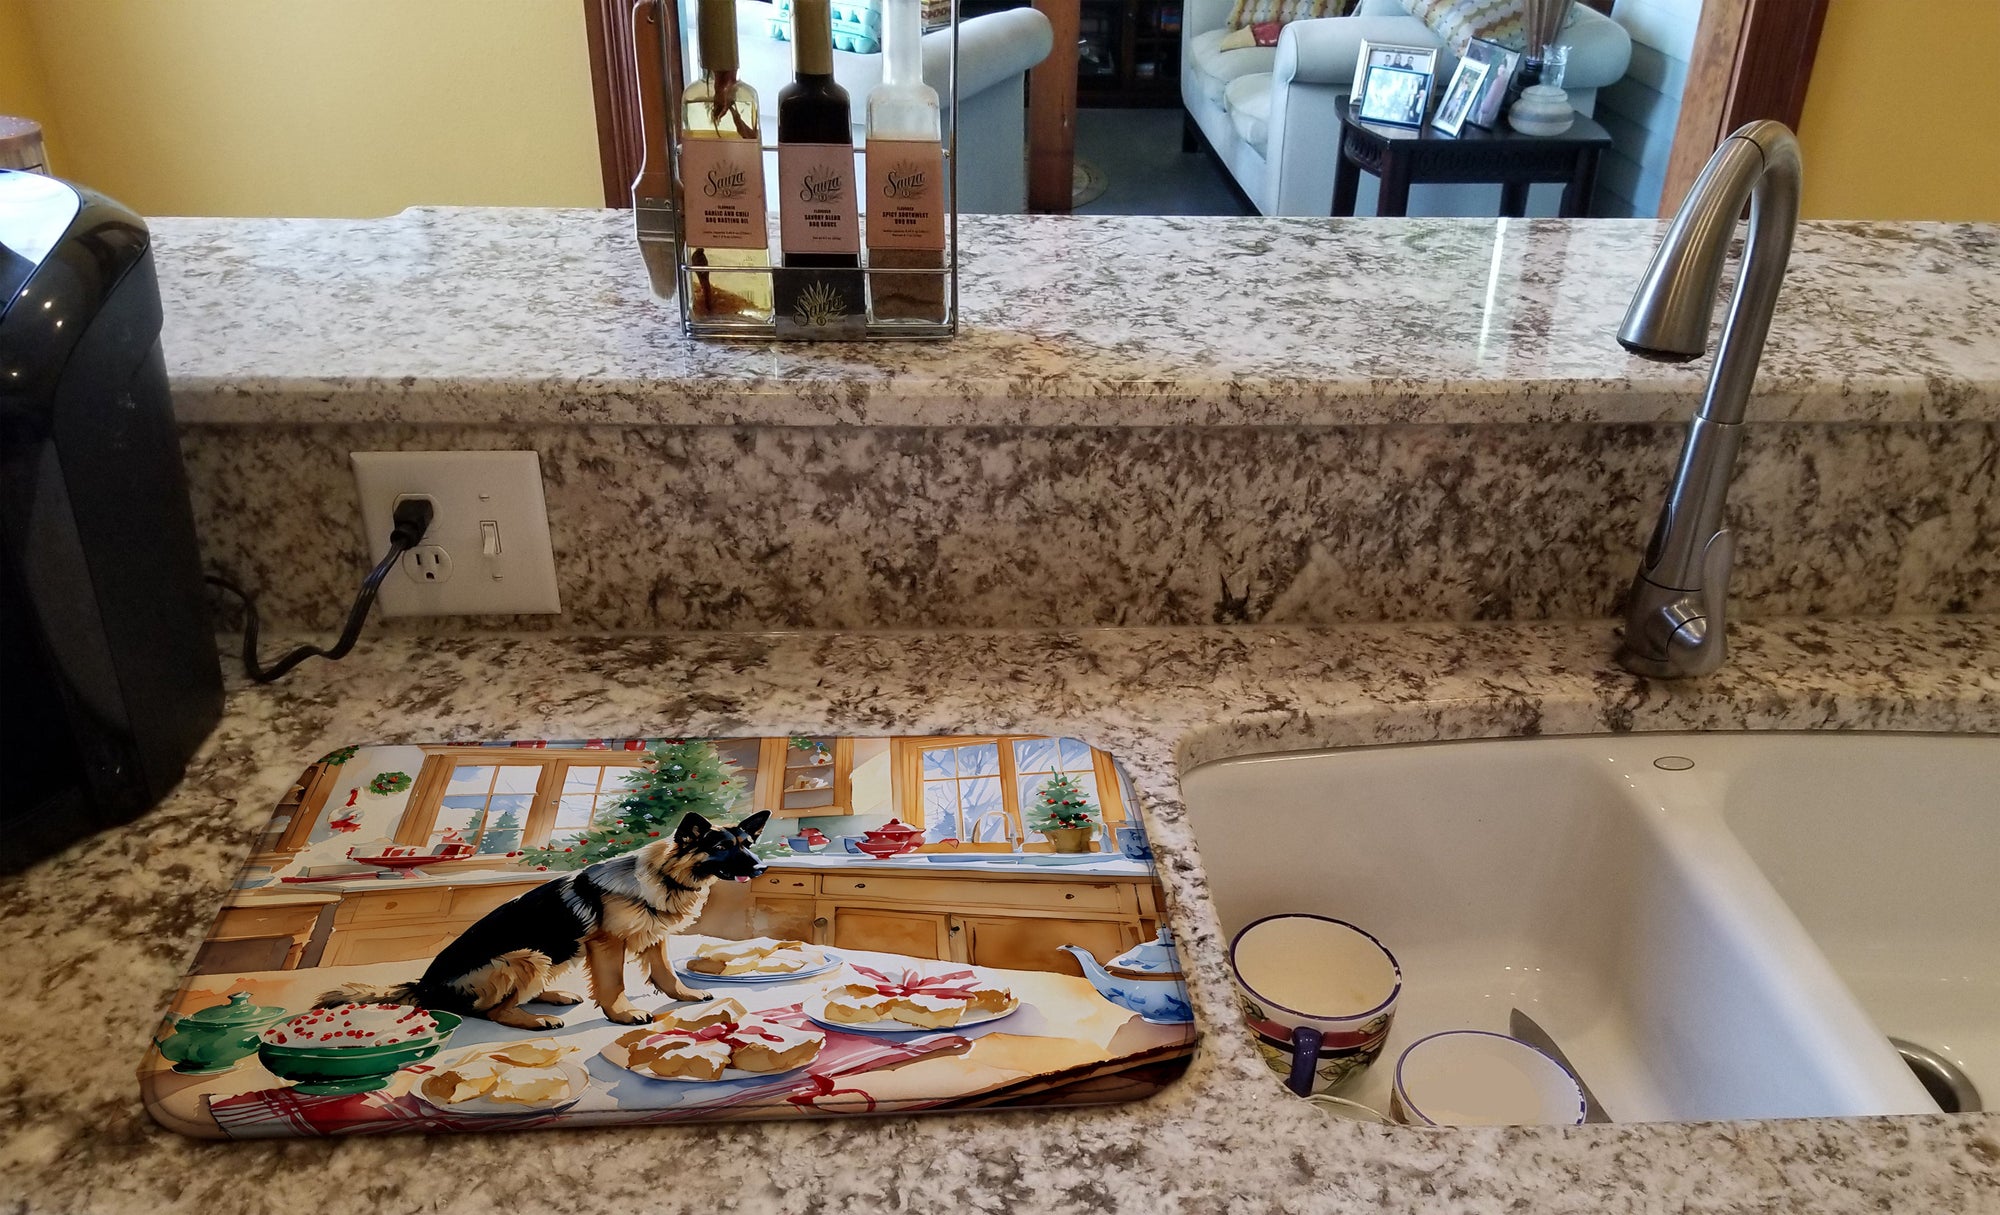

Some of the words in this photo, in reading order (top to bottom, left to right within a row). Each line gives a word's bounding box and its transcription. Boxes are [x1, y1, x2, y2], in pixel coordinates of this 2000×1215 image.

[704, 170, 746, 197] Sauza
[800, 175, 842, 202] Sauza
[884, 170, 926, 198] Sauza
